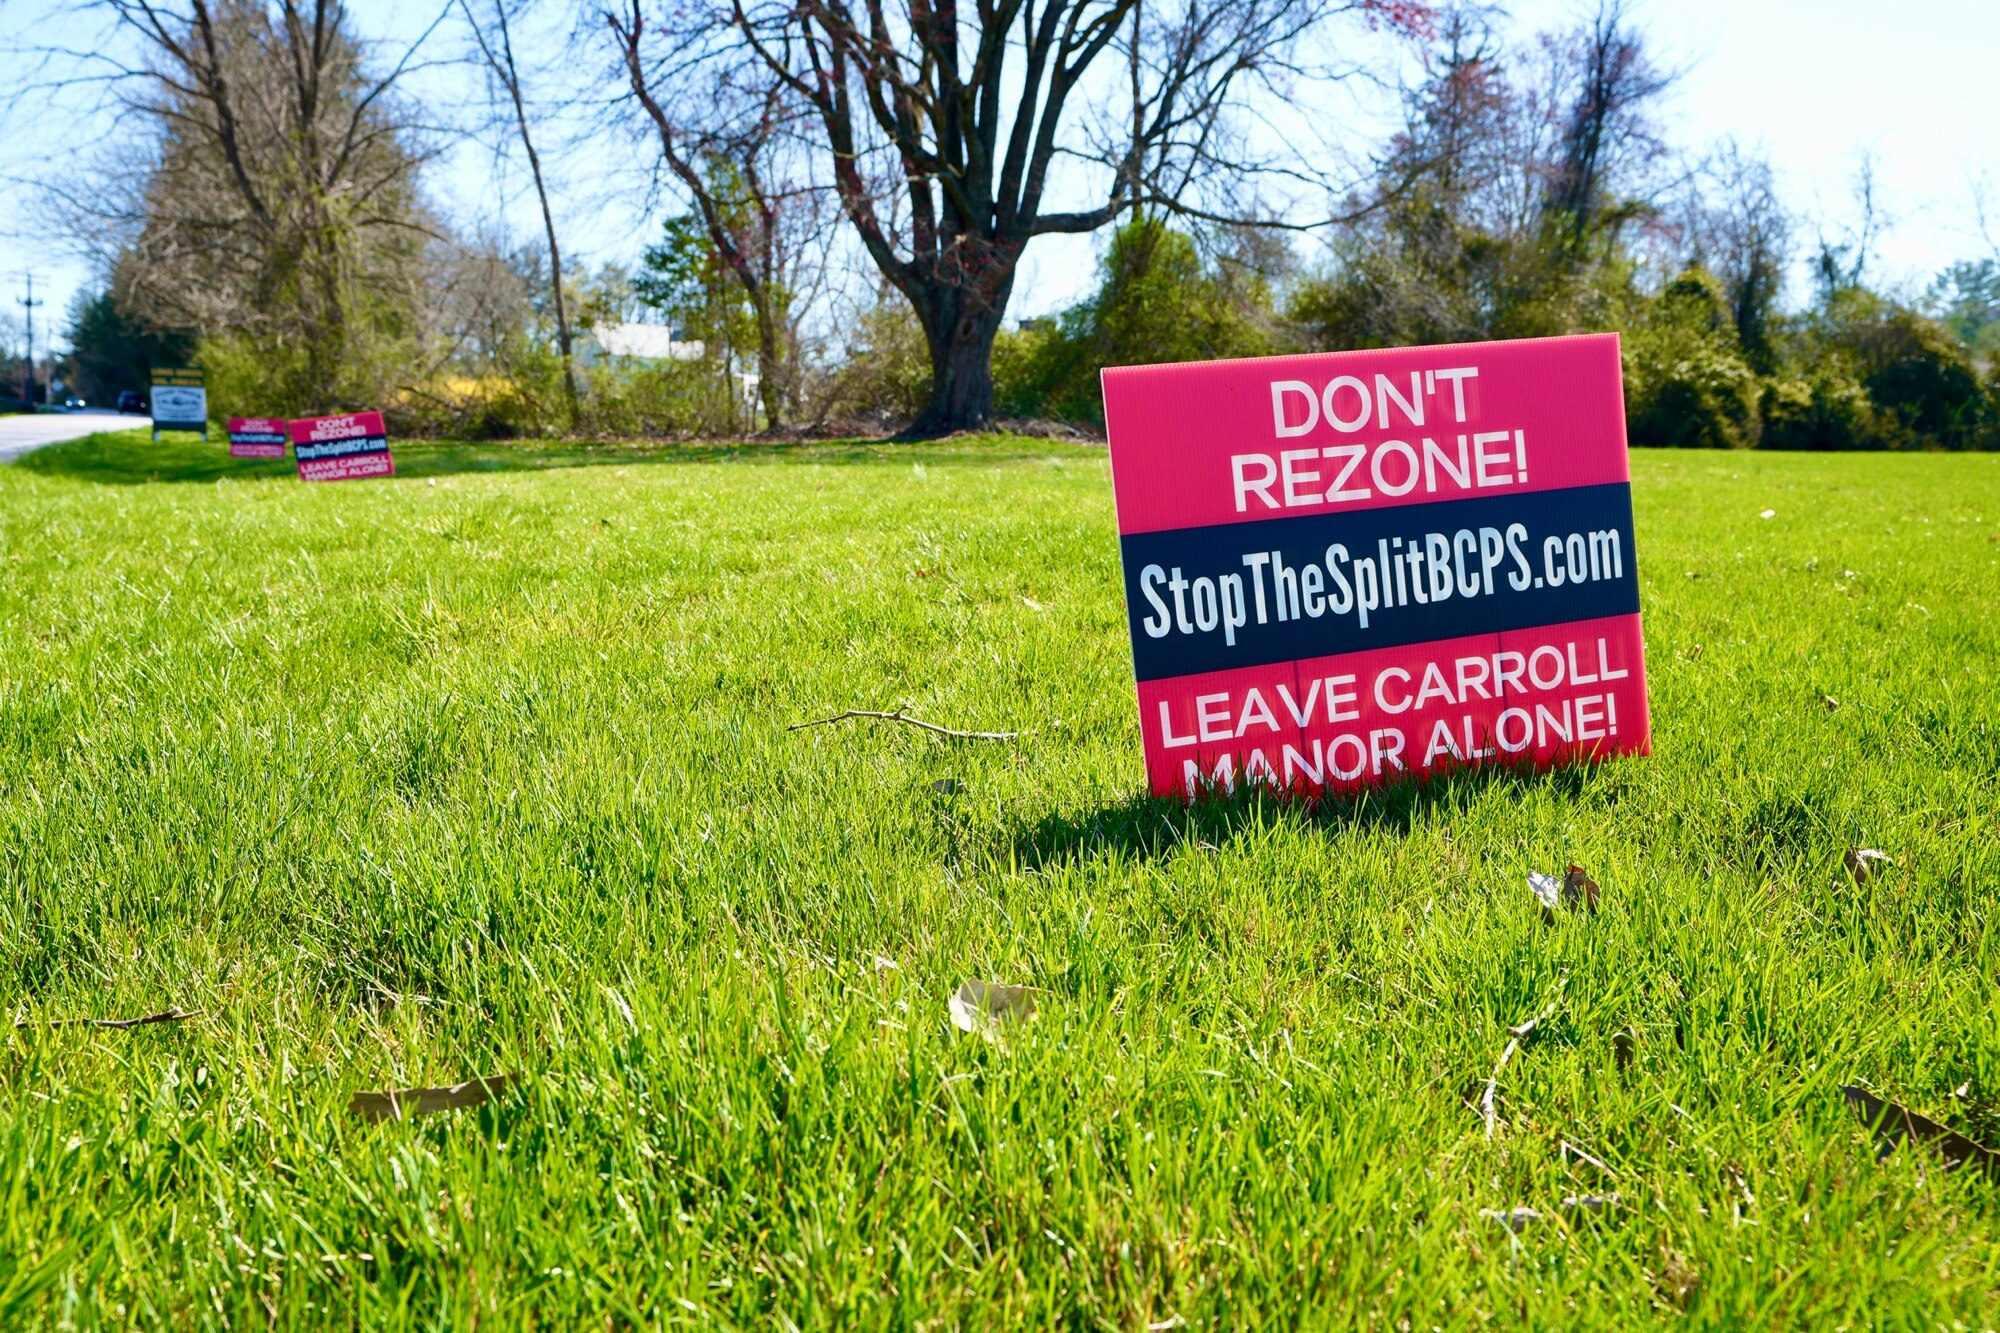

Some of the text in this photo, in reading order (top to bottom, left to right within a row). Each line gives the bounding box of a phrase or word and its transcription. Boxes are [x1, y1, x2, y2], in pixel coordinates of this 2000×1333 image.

[1270, 367, 1479, 438] DON'T
[1231, 430, 1528, 512] REZONE!
[1140, 522, 1623, 646] StopTheSplitBCPS.com
[1159, 638, 1628, 748] LEAVE CARROLL
[1183, 693, 1617, 804] MANOR ALONE!
